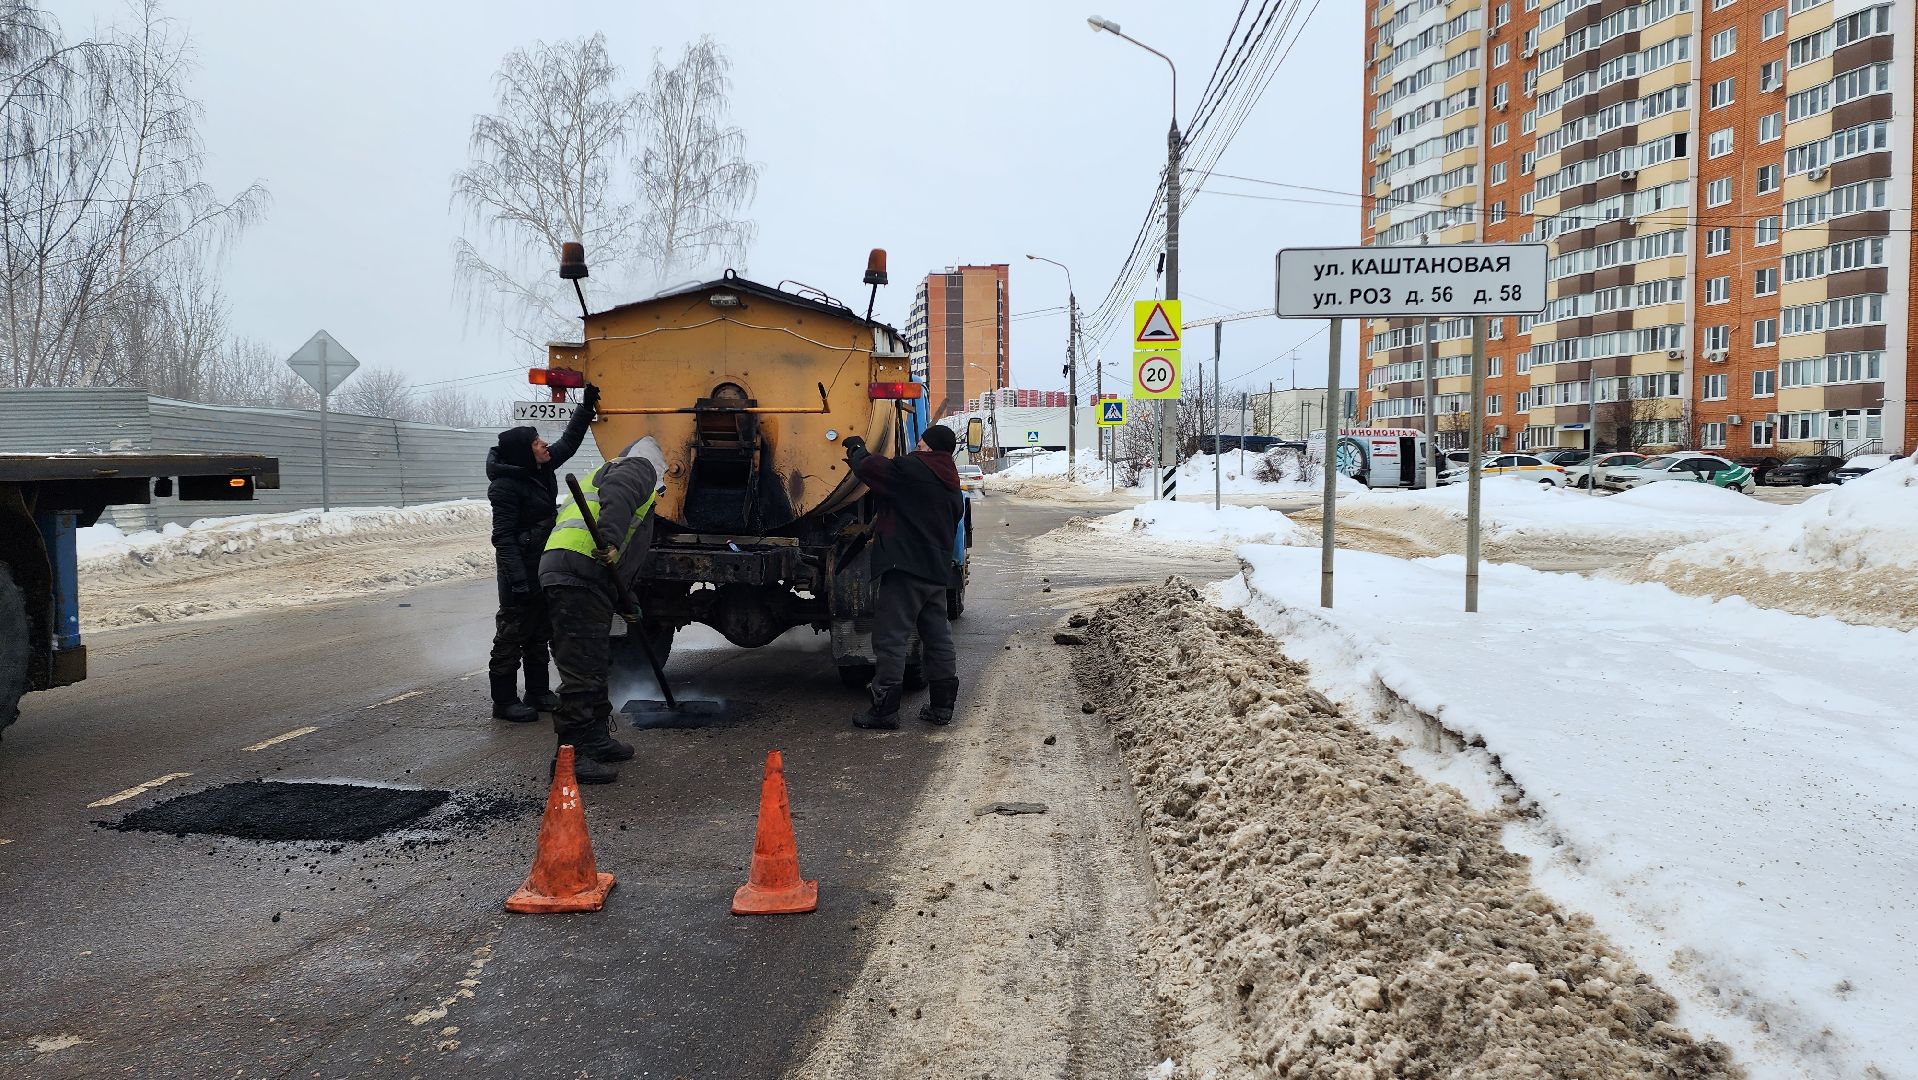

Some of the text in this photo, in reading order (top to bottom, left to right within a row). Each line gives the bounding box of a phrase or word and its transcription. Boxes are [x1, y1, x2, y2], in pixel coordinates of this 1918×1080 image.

[1313, 256, 1511, 281] ул. КАШТАНОВАЯ
[1313, 284, 1521, 309] ул. РОЗ д. 56 д. 58
[1146, 367, 1167, 382] 20
